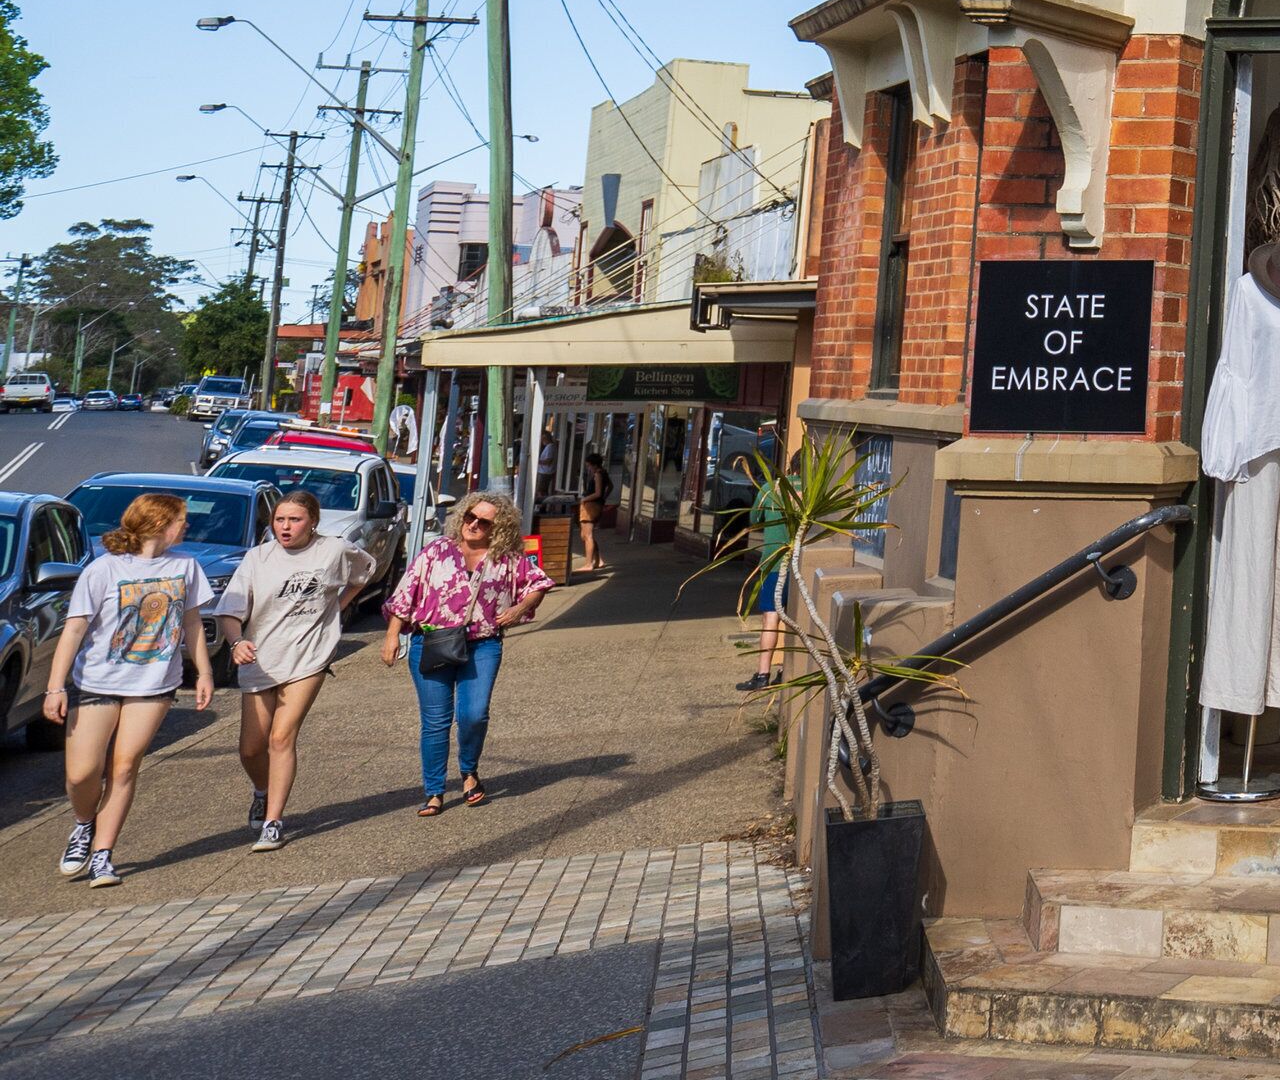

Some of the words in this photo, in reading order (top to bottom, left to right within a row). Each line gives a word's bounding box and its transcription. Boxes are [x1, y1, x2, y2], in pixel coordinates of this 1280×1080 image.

[1025, 294, 1105, 319] STATE
[1044, 330, 1083, 355] OF
[635, 371, 694, 384] Bellingen
[991, 366, 1132, 391] EMBRACE
[634, 386, 668, 396] Kitchen
[671, 386, 694, 397] Shop
